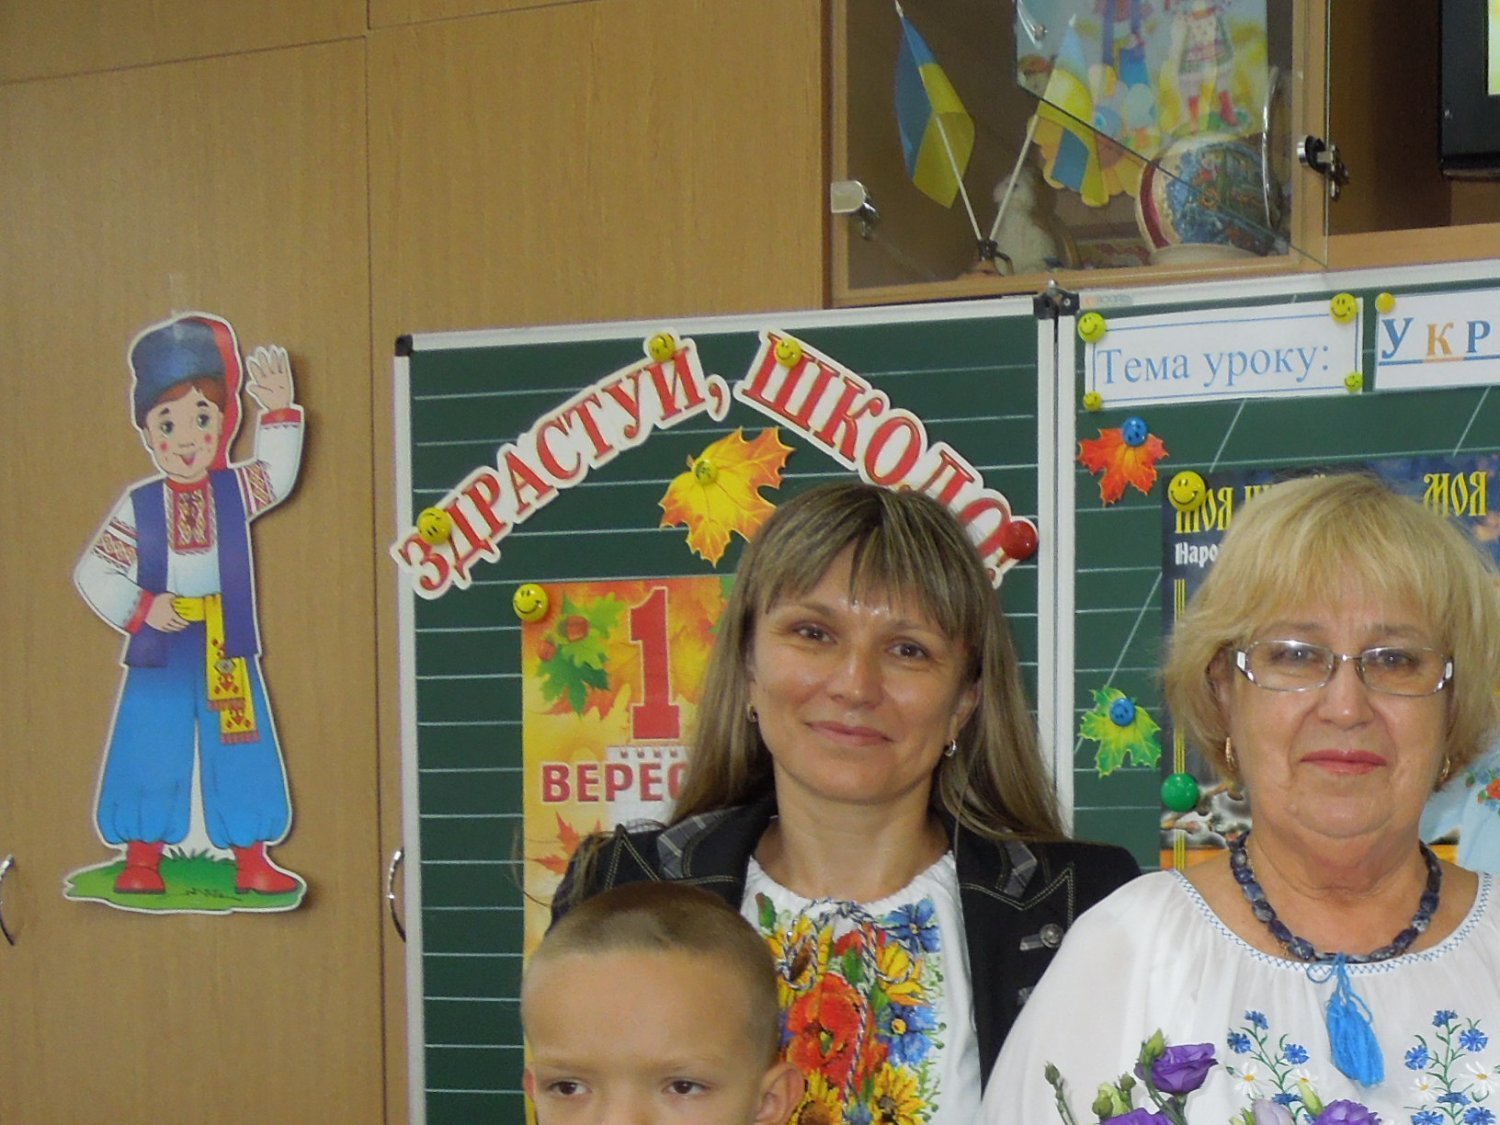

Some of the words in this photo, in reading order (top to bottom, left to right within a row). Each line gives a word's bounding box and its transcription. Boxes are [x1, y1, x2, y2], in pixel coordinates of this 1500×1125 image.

[1096, 349, 1191, 385] Тема
[1203, 344, 1329, 388] уроку:
[1423, 471, 1488, 517] МОЯ
[629, 585, 681, 740] 1
